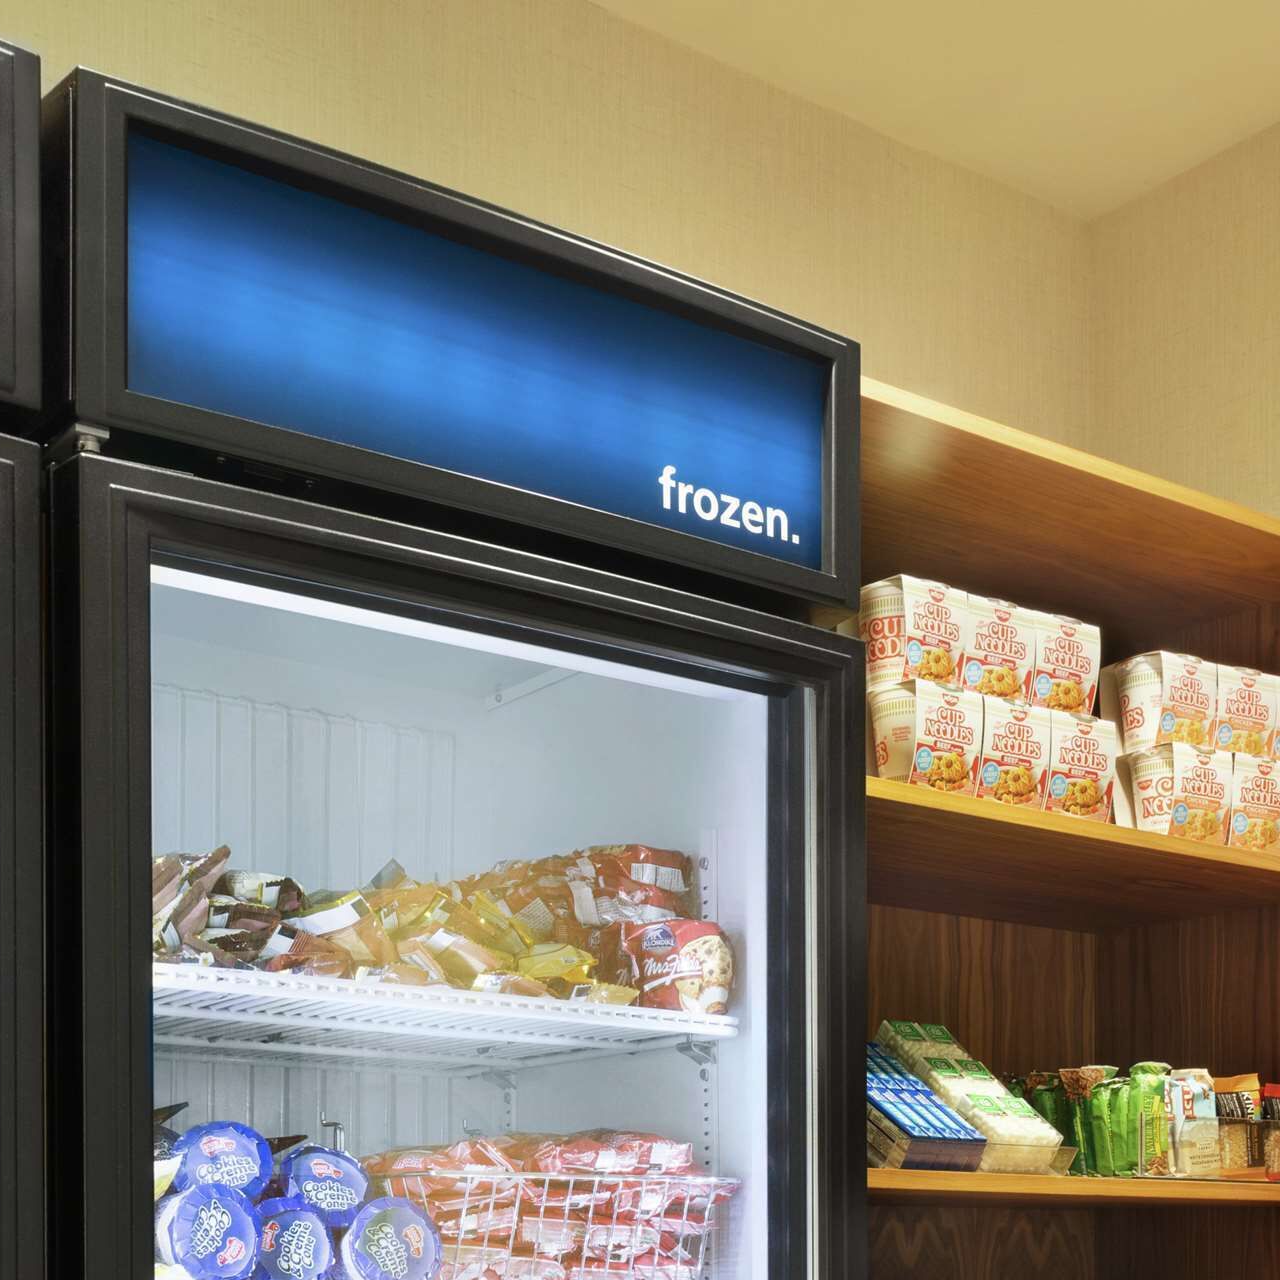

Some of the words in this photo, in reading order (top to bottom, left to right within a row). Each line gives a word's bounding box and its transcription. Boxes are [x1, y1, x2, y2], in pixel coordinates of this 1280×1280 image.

[658, 466, 800, 545] frozen.
[922, 603, 951, 623] CUP
[913, 616, 960, 643] NOODLES
[989, 622, 1018, 643] CUP
[976, 634, 1025, 661] NOODLES
[936, 706, 969, 727] CUP
[926, 719, 973, 745] NOODLES
[1003, 721, 1031, 741] CUP
[993, 733, 1041, 759] NOODLES
